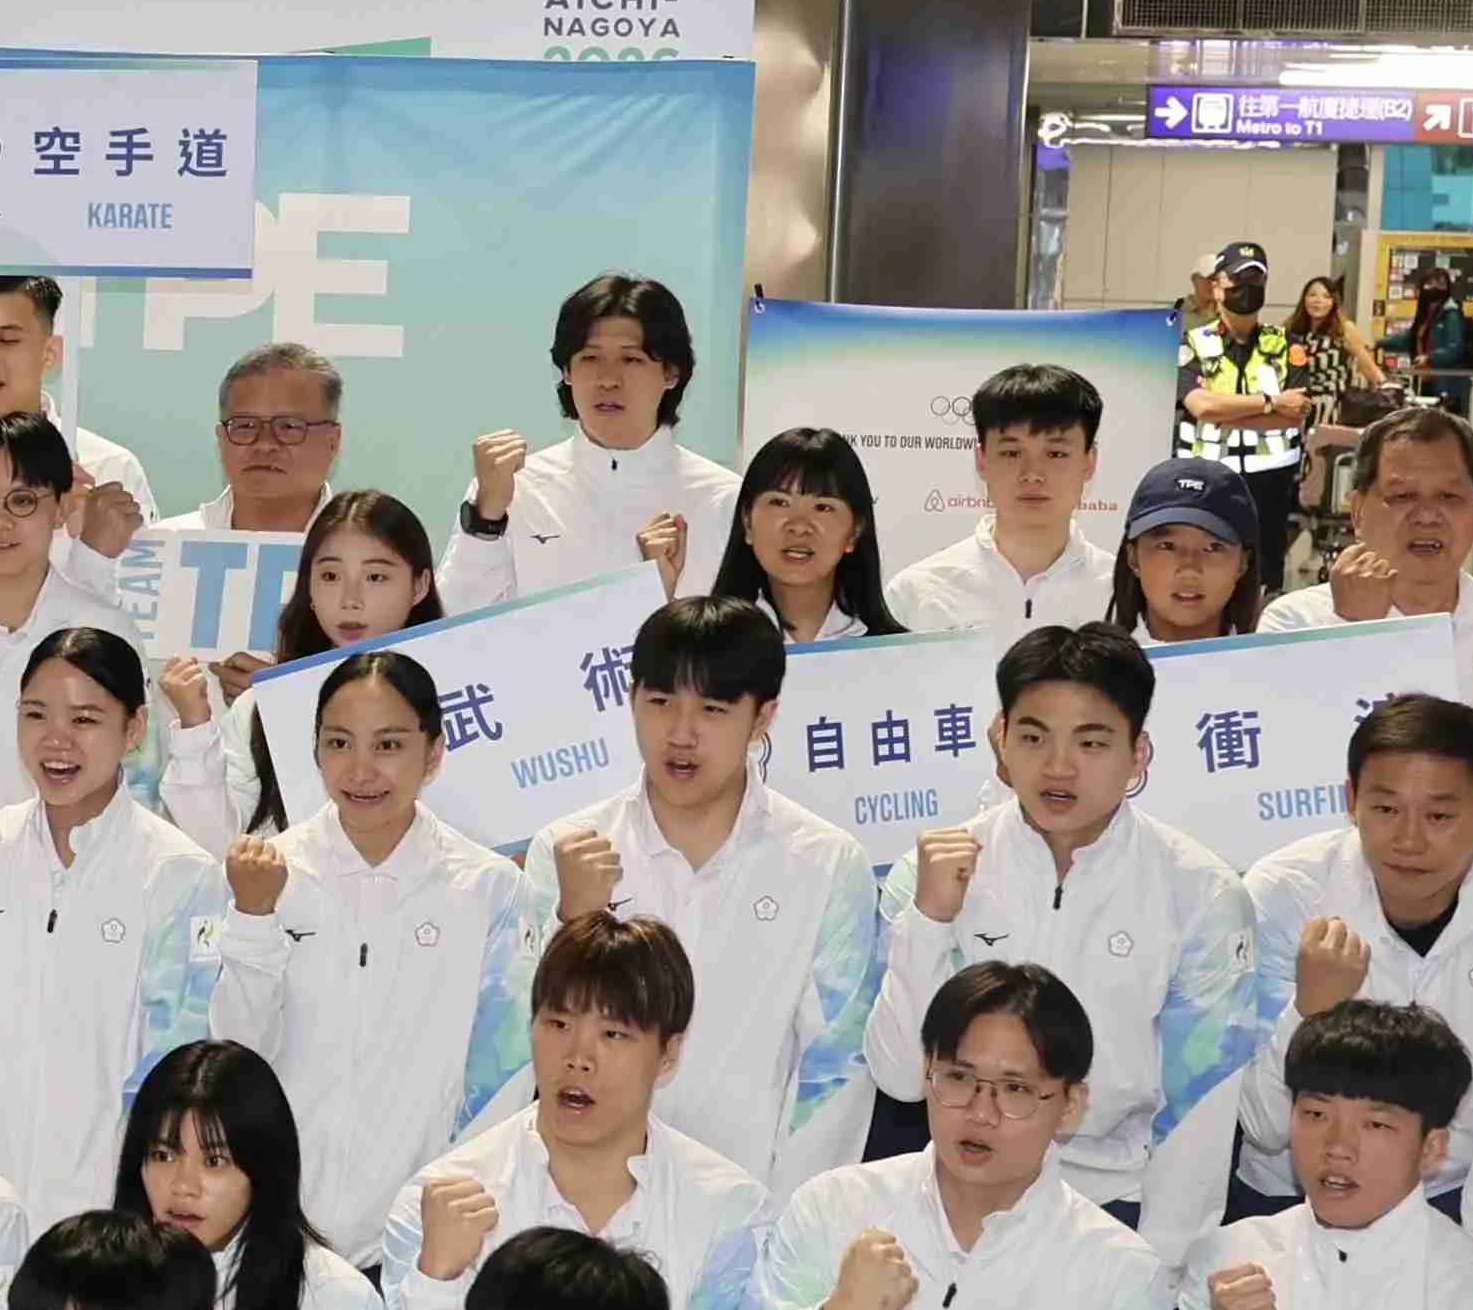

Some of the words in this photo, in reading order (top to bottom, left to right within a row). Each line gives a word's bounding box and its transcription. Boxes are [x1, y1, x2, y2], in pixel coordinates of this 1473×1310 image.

[543, 17, 680, 38] NAGOYA
[1236, 119, 1282, 135] Metro
[1285, 121, 1302, 135] to
[1304, 120, 1324, 136] T1
[33, 126, 228, 177] 空手道
[87, 202, 173, 229] KARATE
[860, 435, 882, 448] YOU
[884, 435, 899, 448] TO
[900, 435, 922, 449] OUR
[1178, 478, 1205, 491] TPE
[805, 703, 976, 773] 自由車
[509, 737, 610, 789] WUSHU
[853, 787, 939, 824] CYCLING
